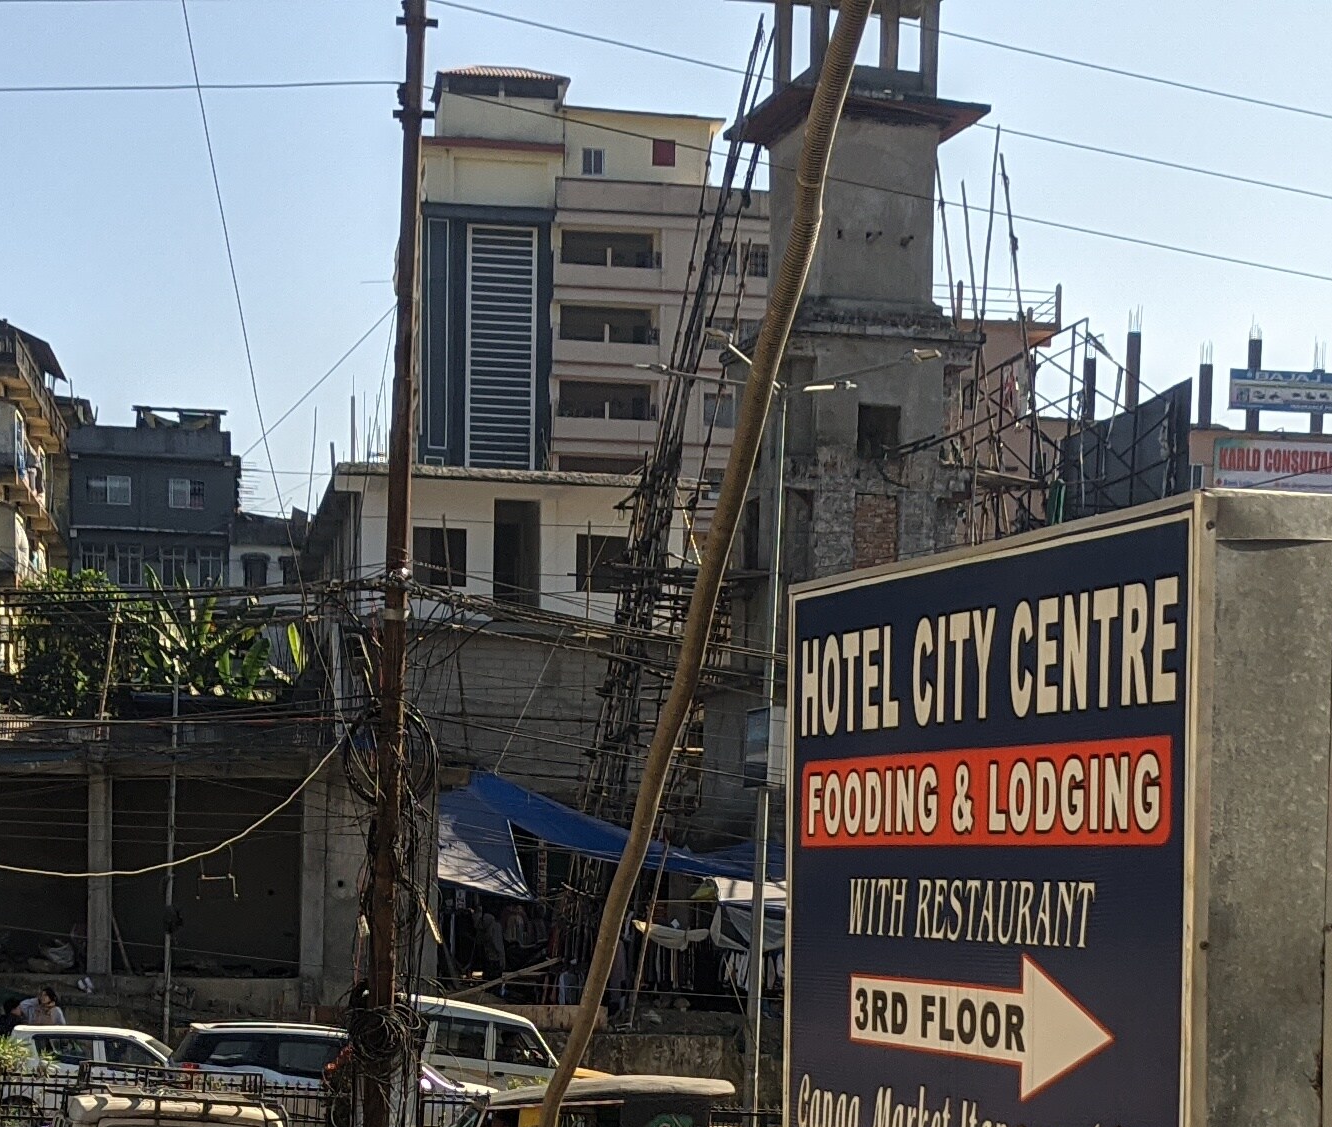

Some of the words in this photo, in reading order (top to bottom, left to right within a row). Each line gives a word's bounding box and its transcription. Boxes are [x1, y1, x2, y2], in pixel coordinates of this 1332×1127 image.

[1255, 371, 1322, 383] BAJAJ
[800, 624, 899, 738] HOTEL
[912, 607, 997, 728] CITY
[1009, 575, 1180, 719] CENTRE
[807, 764, 939, 838] FOODING
[951, 761, 974, 833] &
[987, 750, 1162, 835] LODGING
[848, 878, 908, 938] WITH
[914, 878, 1096, 949] RESTAURANT
[854, 987, 909, 1036] 3RD
[920, 994, 1026, 1053] FLOOR
